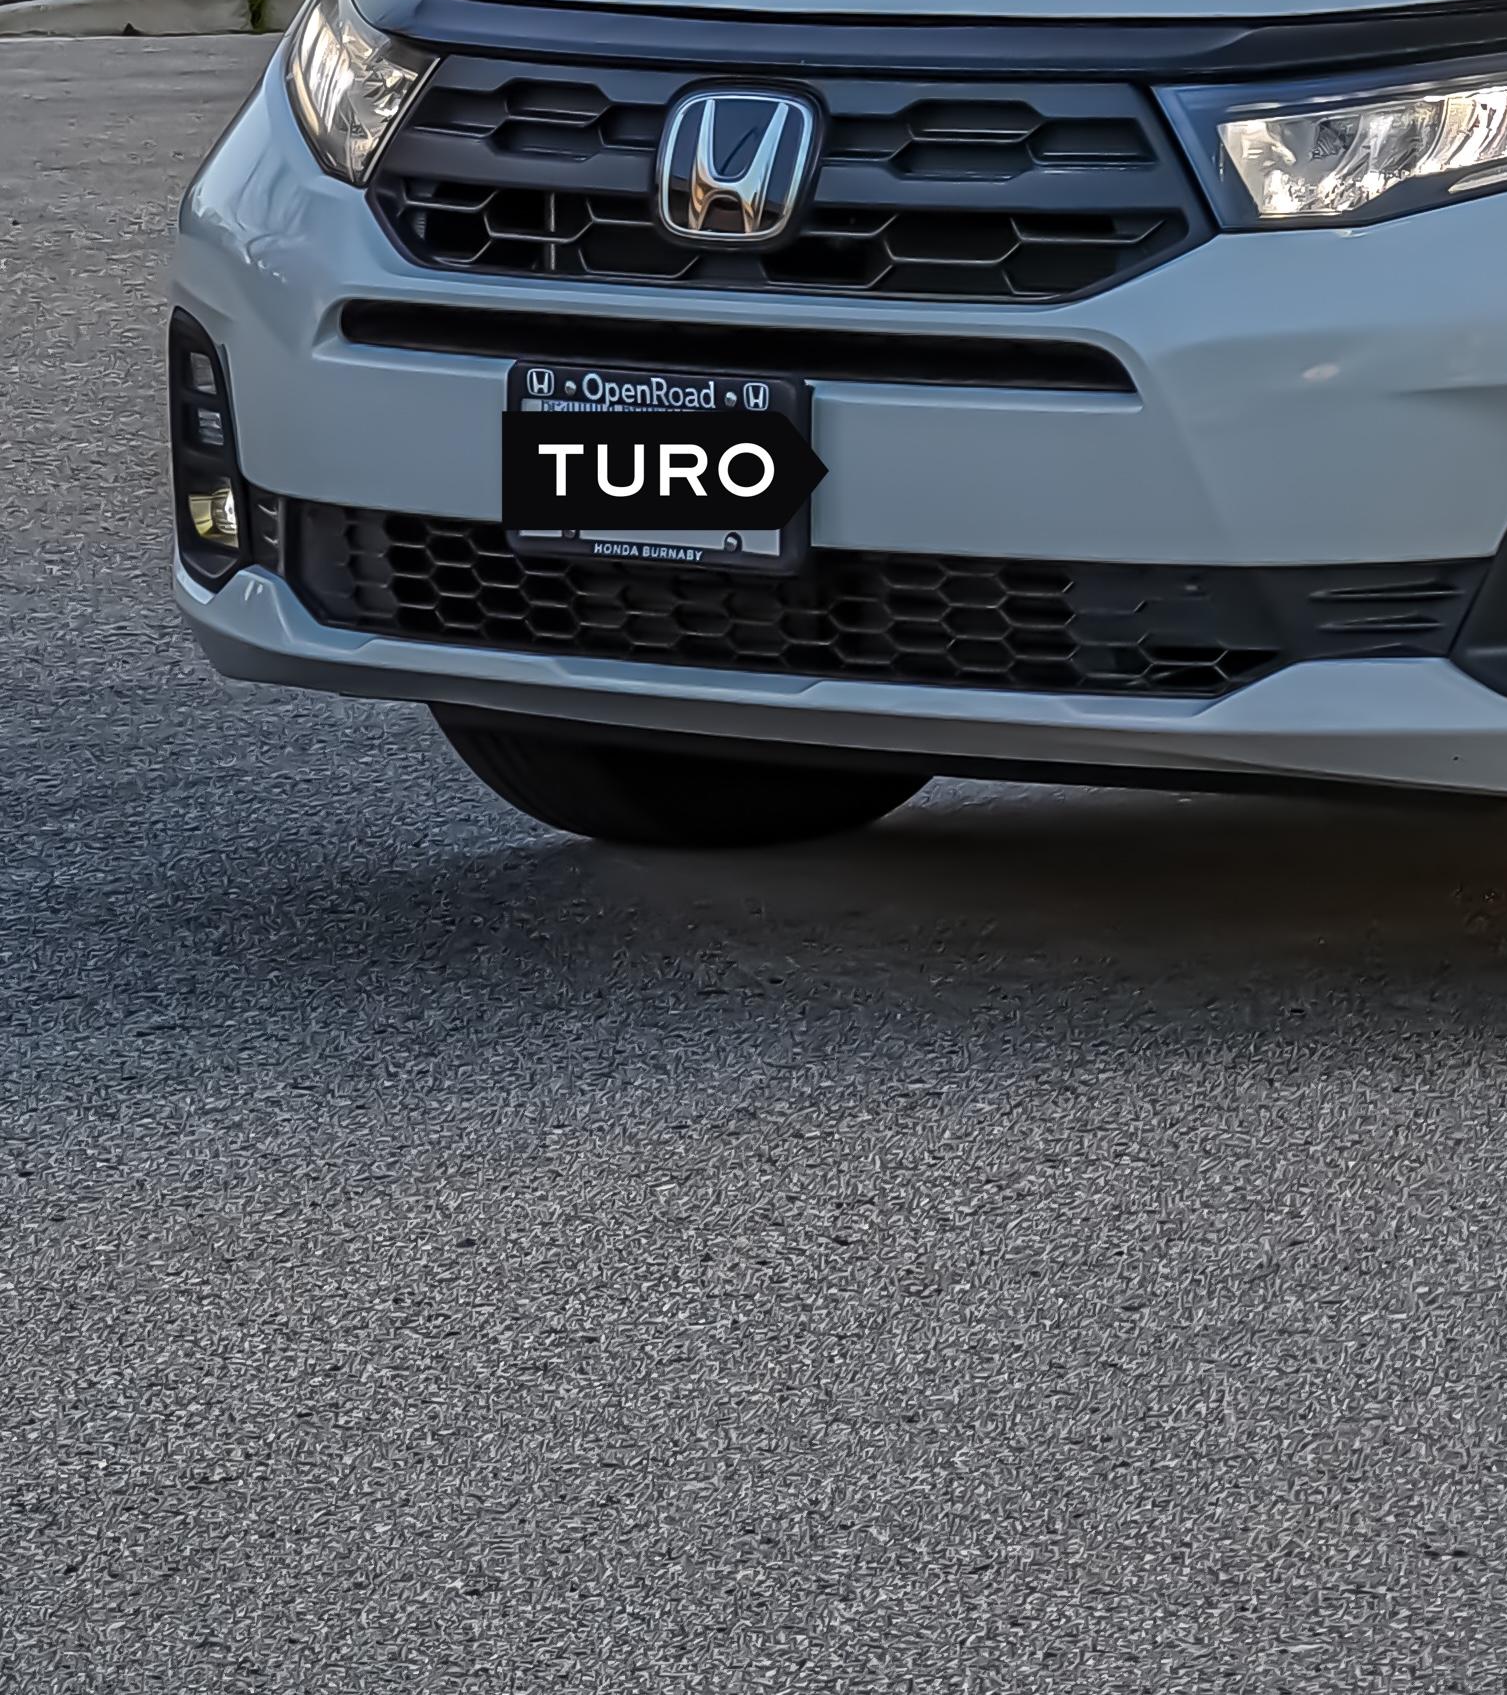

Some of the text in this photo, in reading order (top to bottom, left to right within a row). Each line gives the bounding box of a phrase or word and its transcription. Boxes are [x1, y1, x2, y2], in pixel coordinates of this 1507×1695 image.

[582, 372, 716, 409] OpenRoad
[593, 542, 703, 561] HONDA BURNABY
